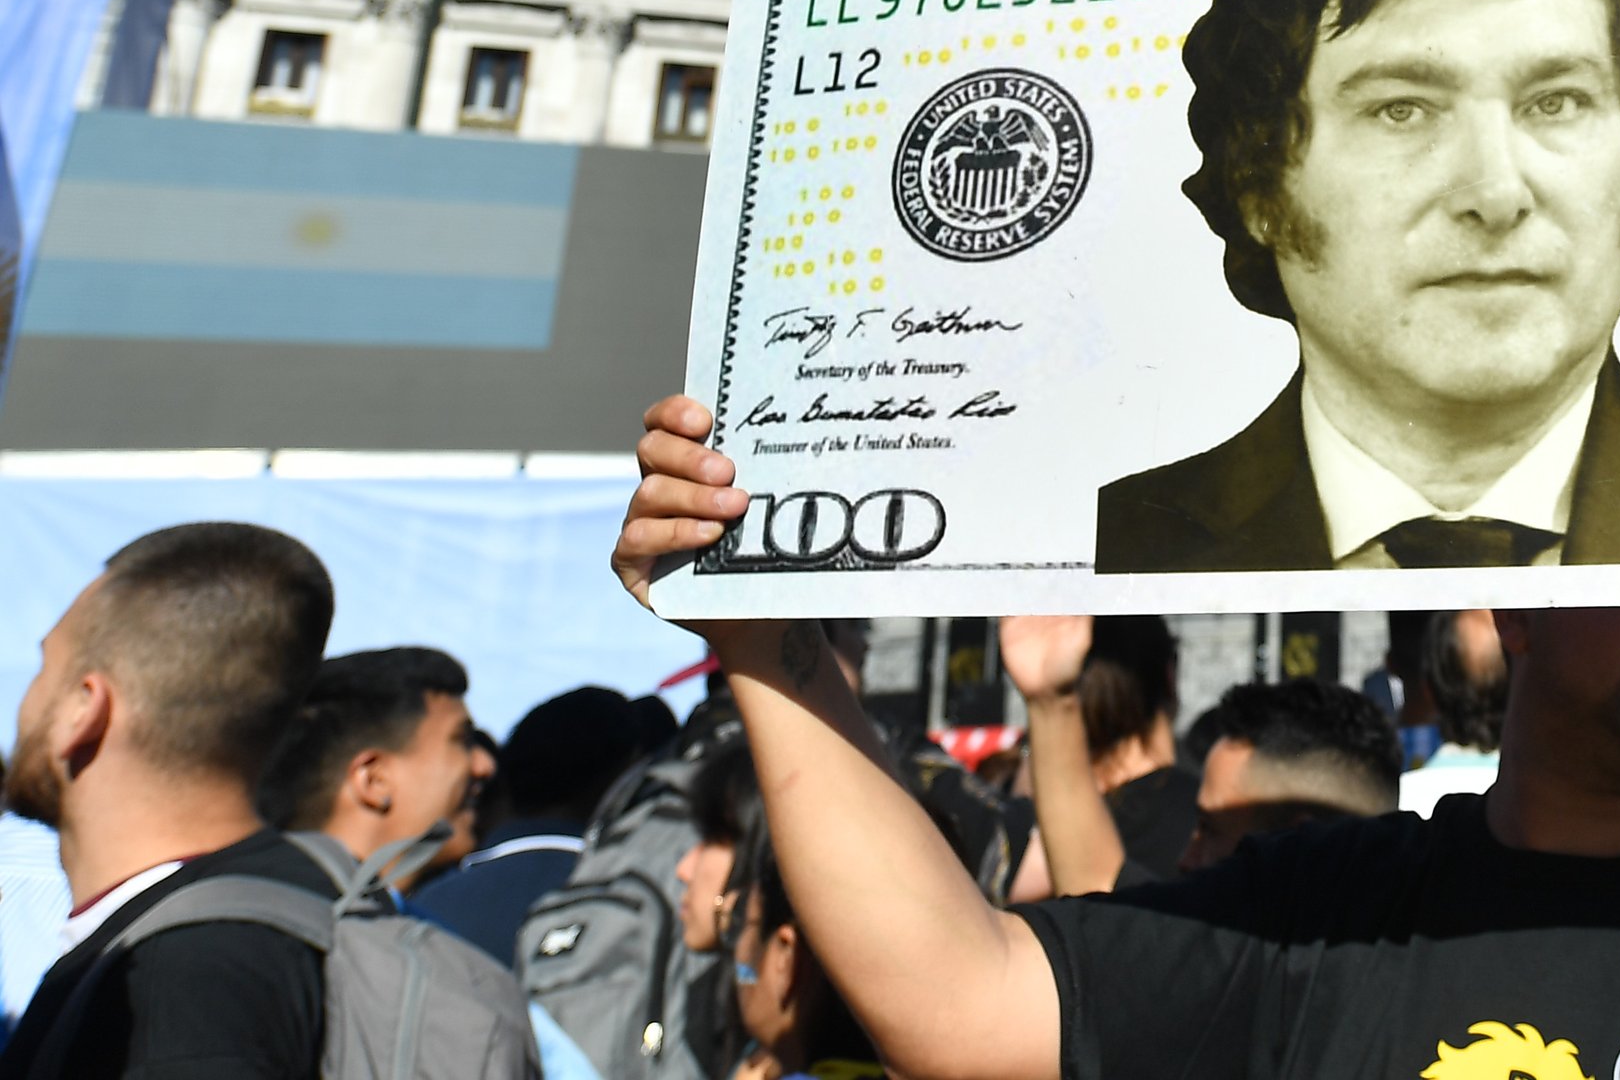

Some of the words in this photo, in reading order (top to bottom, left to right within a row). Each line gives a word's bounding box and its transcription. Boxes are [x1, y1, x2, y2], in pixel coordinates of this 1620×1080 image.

[793, 47, 882, 95] L12
[922, 78, 997, 130] UNITED
[1002, 78, 1068, 123] STATES
[901, 147, 934, 233] FEDERAL
[934, 221, 1031, 251] RESERVE
[1033, 137, 1080, 223] SYSTEM
[795, 362, 854, 381] Secretary
[857, 360, 877, 380] of
[877, 359, 896, 377] the
[902, 358, 971, 378] Treasury.
[752, 437, 809, 455] Treasurer
[811, 435, 831, 457] of
[830, 435, 849, 452] the
[853, 433, 902, 452] United
[907, 432, 956, 451] States.
[722, 488, 947, 565] 100
